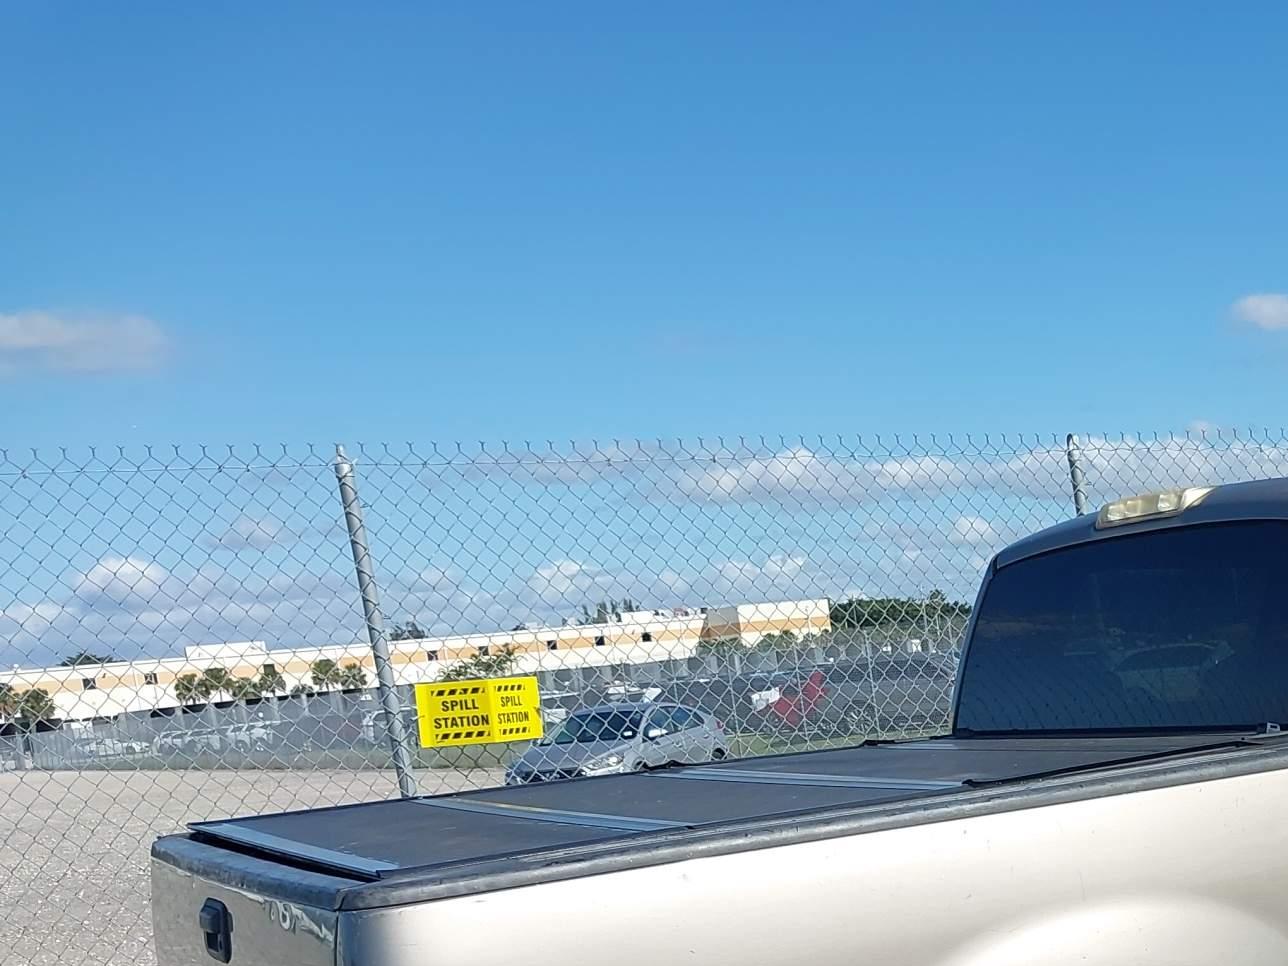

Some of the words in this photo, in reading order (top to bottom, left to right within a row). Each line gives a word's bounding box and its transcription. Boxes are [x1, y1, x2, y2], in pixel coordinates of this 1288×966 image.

[441, 698, 479, 712] SPILL
[500, 695, 523, 708] SPILL
[433, 714, 490, 729] STATION
[497, 711, 529, 724] STATION
